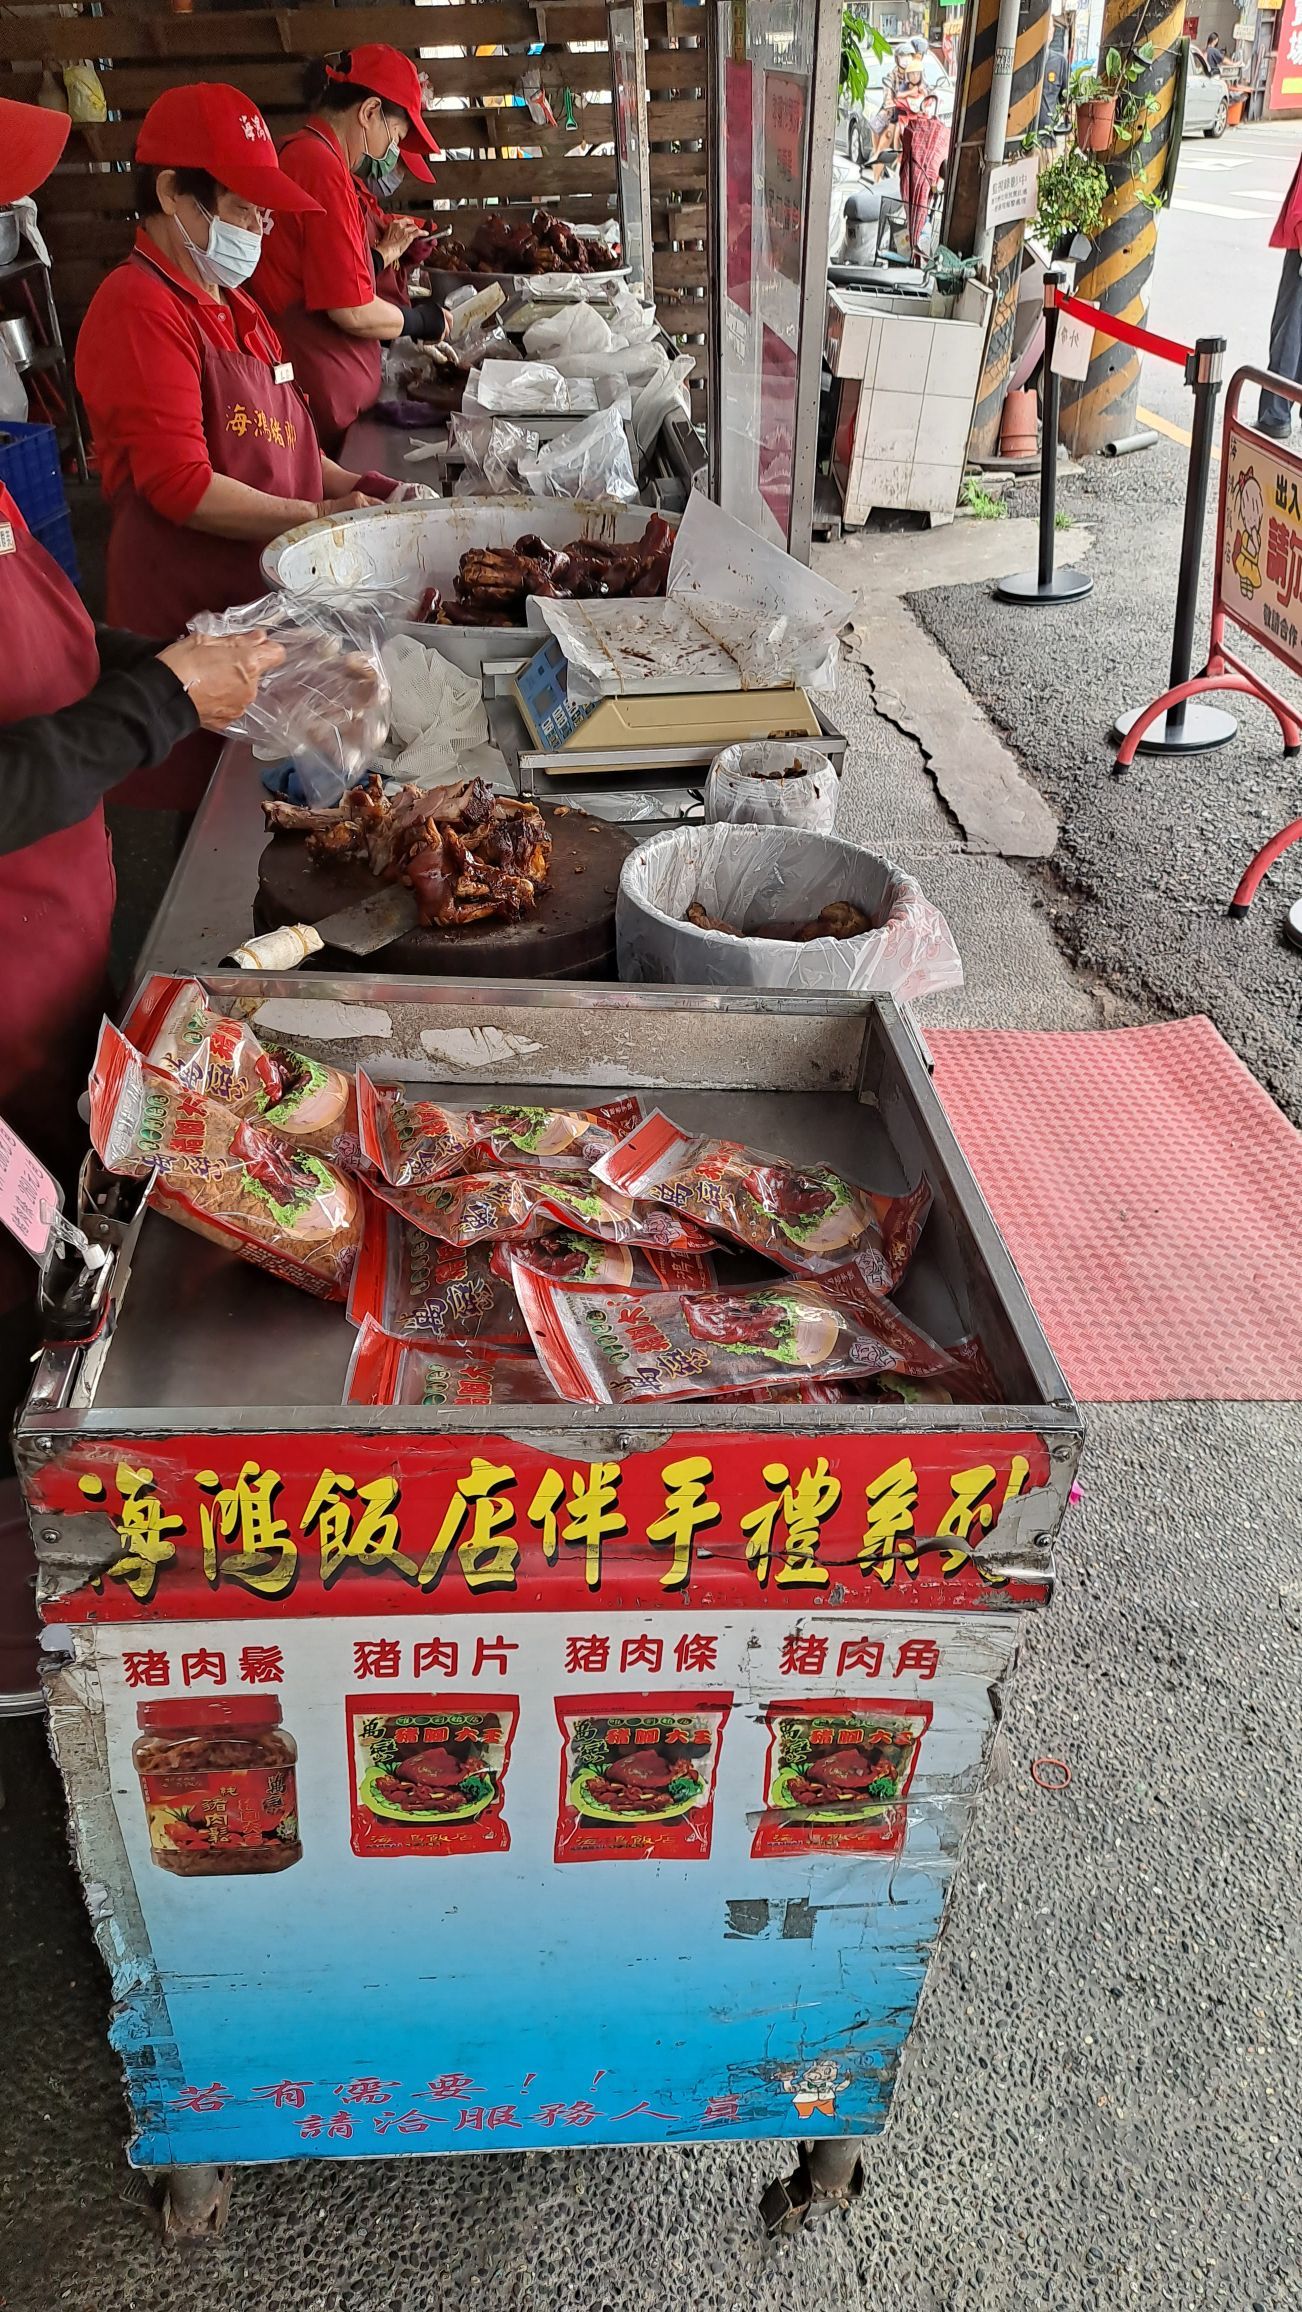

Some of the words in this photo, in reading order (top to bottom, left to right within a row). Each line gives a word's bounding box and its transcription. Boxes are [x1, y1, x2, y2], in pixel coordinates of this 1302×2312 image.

[122, 1644, 286, 1688] 豬肉鬆
[352, 1635, 520, 1680] 豬肉片
[564, 1633, 719, 1675] 豬肉條
[778, 1634, 942, 1681] 豬肉角
[292, 2094, 742, 2140] 請洽服務人員
